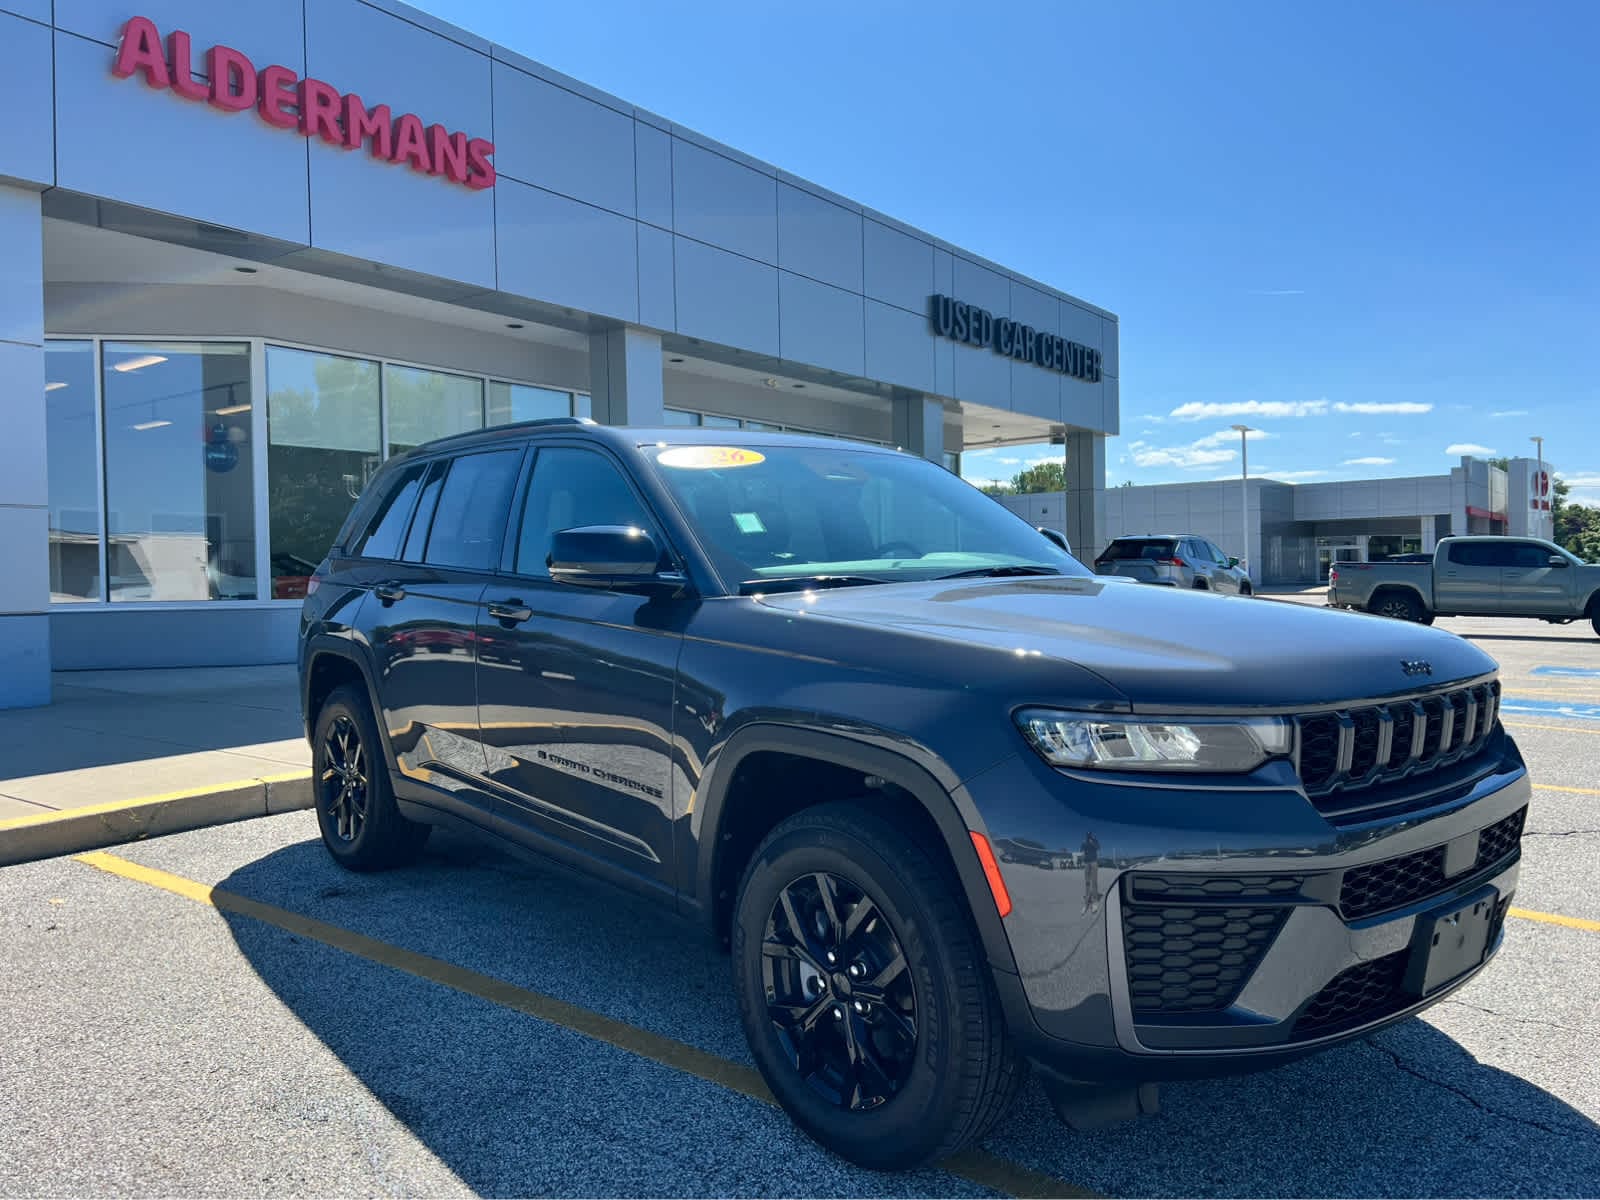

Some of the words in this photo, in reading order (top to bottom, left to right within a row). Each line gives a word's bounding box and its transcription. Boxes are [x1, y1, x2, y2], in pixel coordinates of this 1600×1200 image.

[112, 16, 497, 190] ALDERMANS
[931, 294, 993, 348] USED
[993, 317, 1037, 363] CAR
[1036, 332, 1102, 383] CENTER
